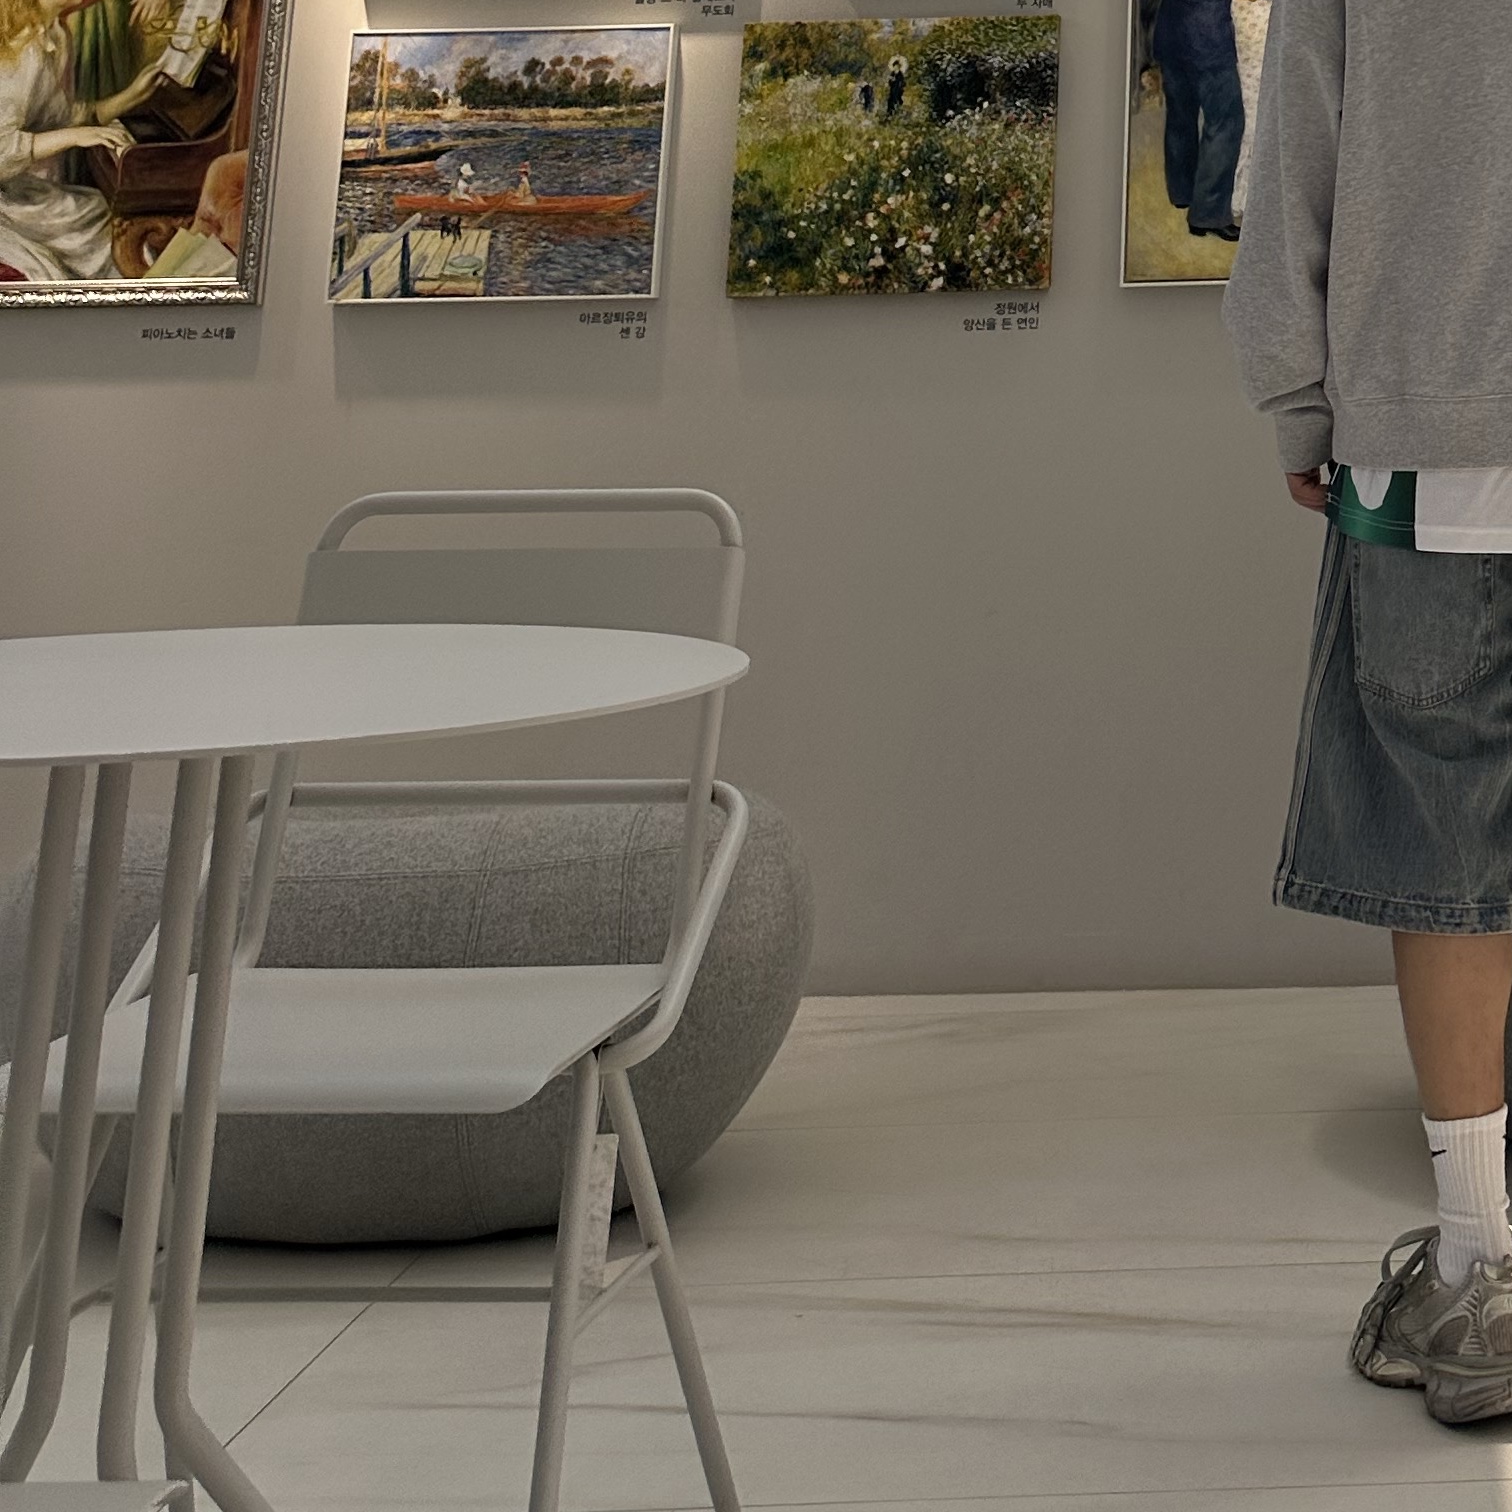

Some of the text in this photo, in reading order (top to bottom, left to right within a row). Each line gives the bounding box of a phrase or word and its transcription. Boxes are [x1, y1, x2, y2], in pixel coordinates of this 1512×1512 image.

[701, 4, 735, 17] 무도회
[993, 300, 1040, 316] 정원에서
[578, 310, 648, 325] 아르장퇴유의
[962, 316, 1040, 332] 양산을 든 연인
[635, 326, 646, 340] 강
